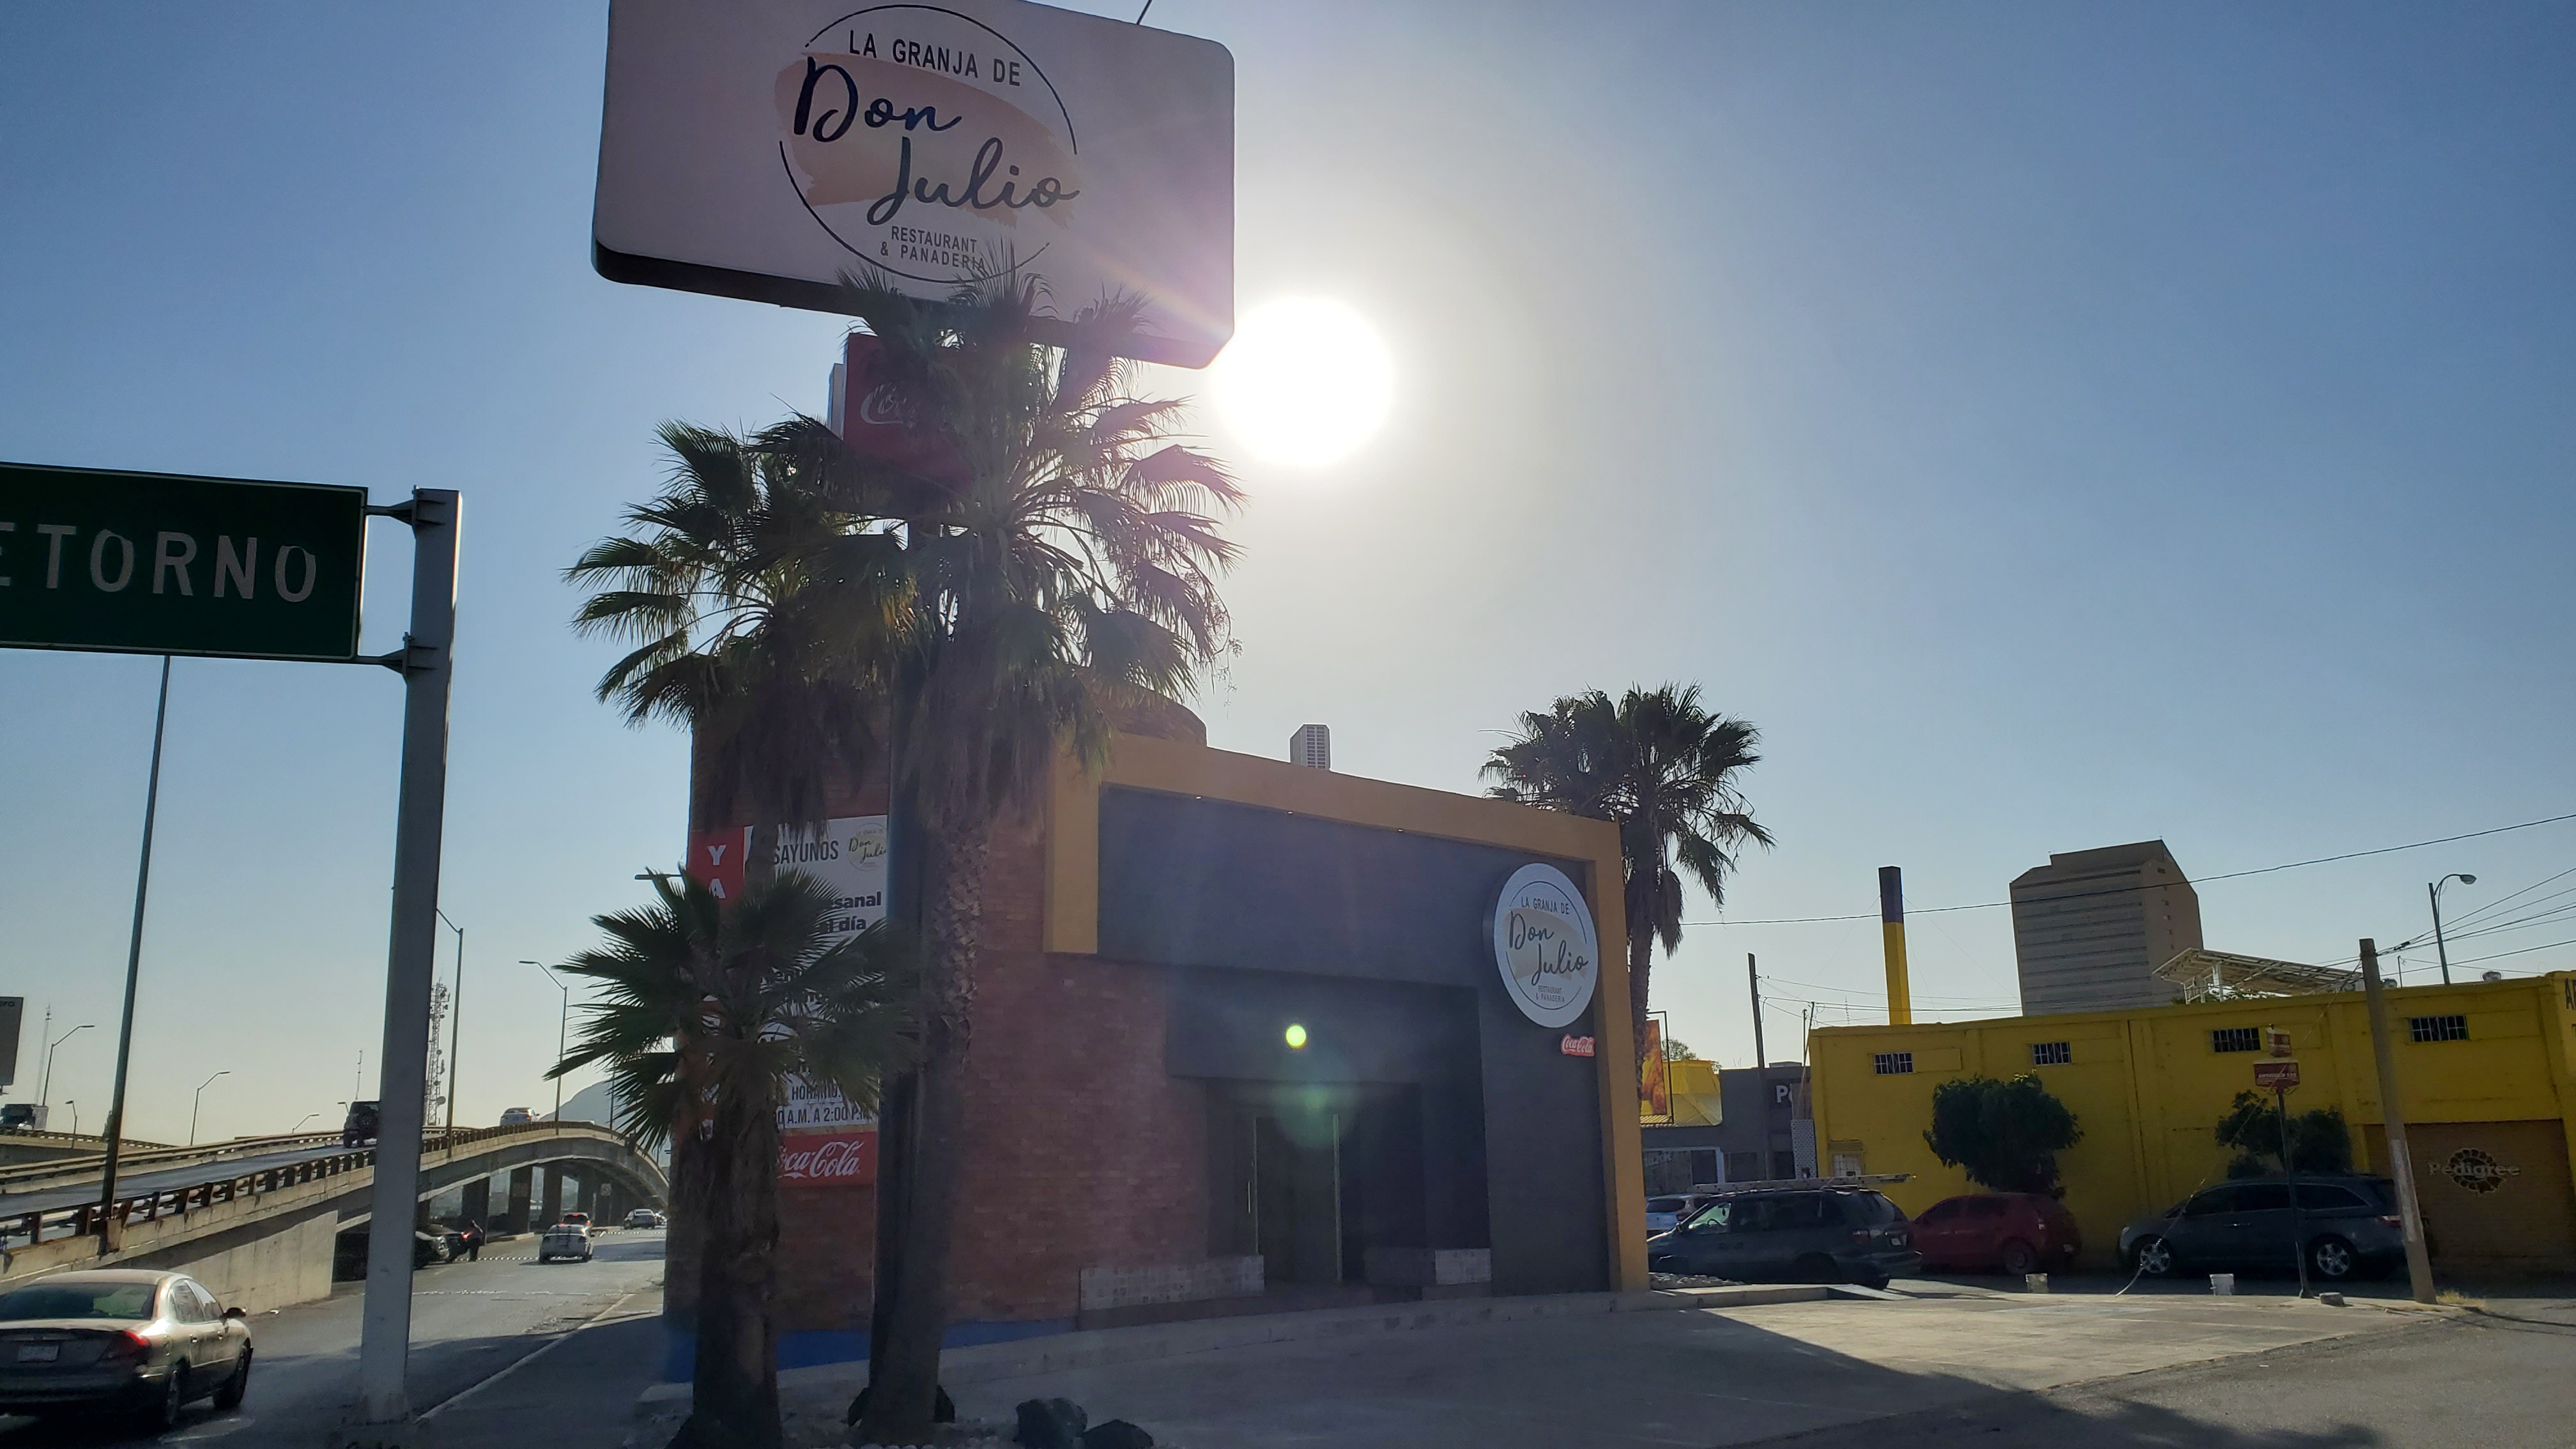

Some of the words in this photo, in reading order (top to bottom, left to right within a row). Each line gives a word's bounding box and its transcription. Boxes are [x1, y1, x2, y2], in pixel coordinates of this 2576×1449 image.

[849, 30, 877, 58] LA
[893, 38, 978, 78] GRANJA
[993, 59, 1020, 87] DE
[793, 56, 962, 142] Don
[866, 136, 1080, 226] Julio
[891, 226, 977, 253] RESTAURANT
[880, 241, 889, 256] &
[901, 245, 985, 271] PANADERIA
[1521, 896, 1529, 908] LA
[1533, 898, 1557, 913] GRANJA
[1561, 903, 1569, 914] DE
[839, 916, 866, 931] día
[1509, 910, 1554, 950] Don
[1531, 939, 1588, 986] Julio
[1562, 1035, 1594, 1054] Coca-Cola
[787, 1109, 810, 1124] A.M.
[814, 1108, 820, 1123] A
[824, 1106, 848, 1122] 2:00
[2427, 1161, 2521, 1179] Pedigree
